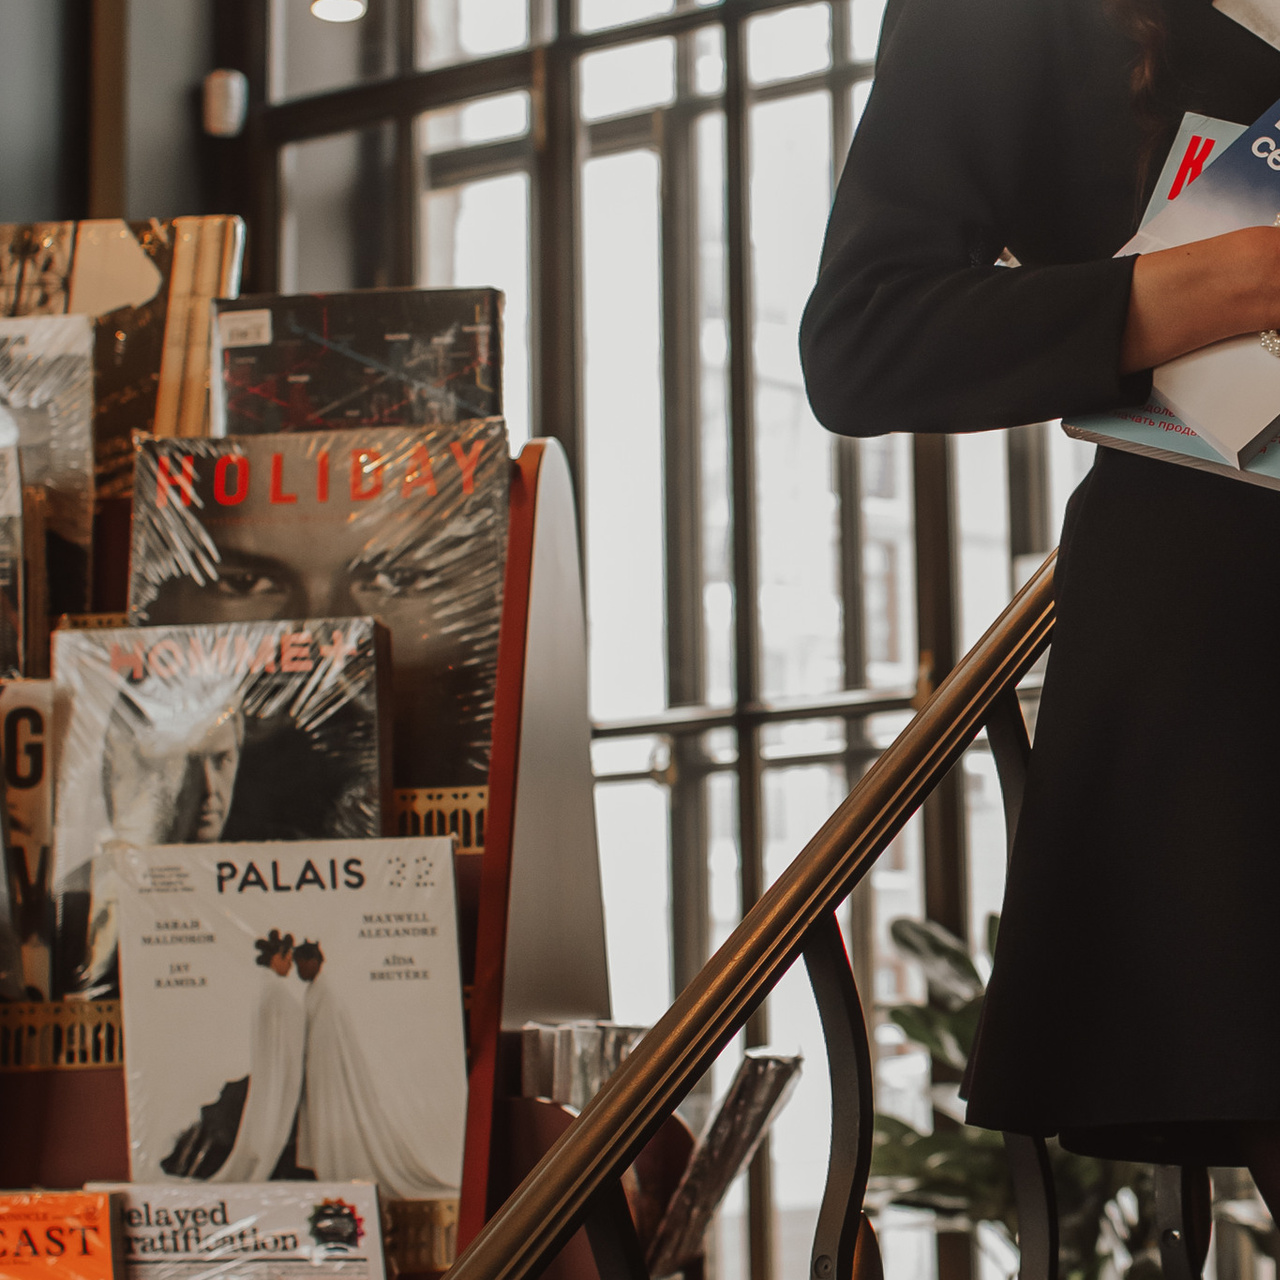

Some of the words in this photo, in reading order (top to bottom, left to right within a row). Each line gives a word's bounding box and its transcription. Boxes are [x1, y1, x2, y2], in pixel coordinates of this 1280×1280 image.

[155, 440, 486, 508] HOLIDAY
[216, 858, 366, 894] PALAIS
[362, 911, 430, 924] MAXWELL
[358, 926, 438, 938] ALEXANDRE
[126, 1201, 229, 1229] elayed
[125, 1226, 299, 1254] ratification
